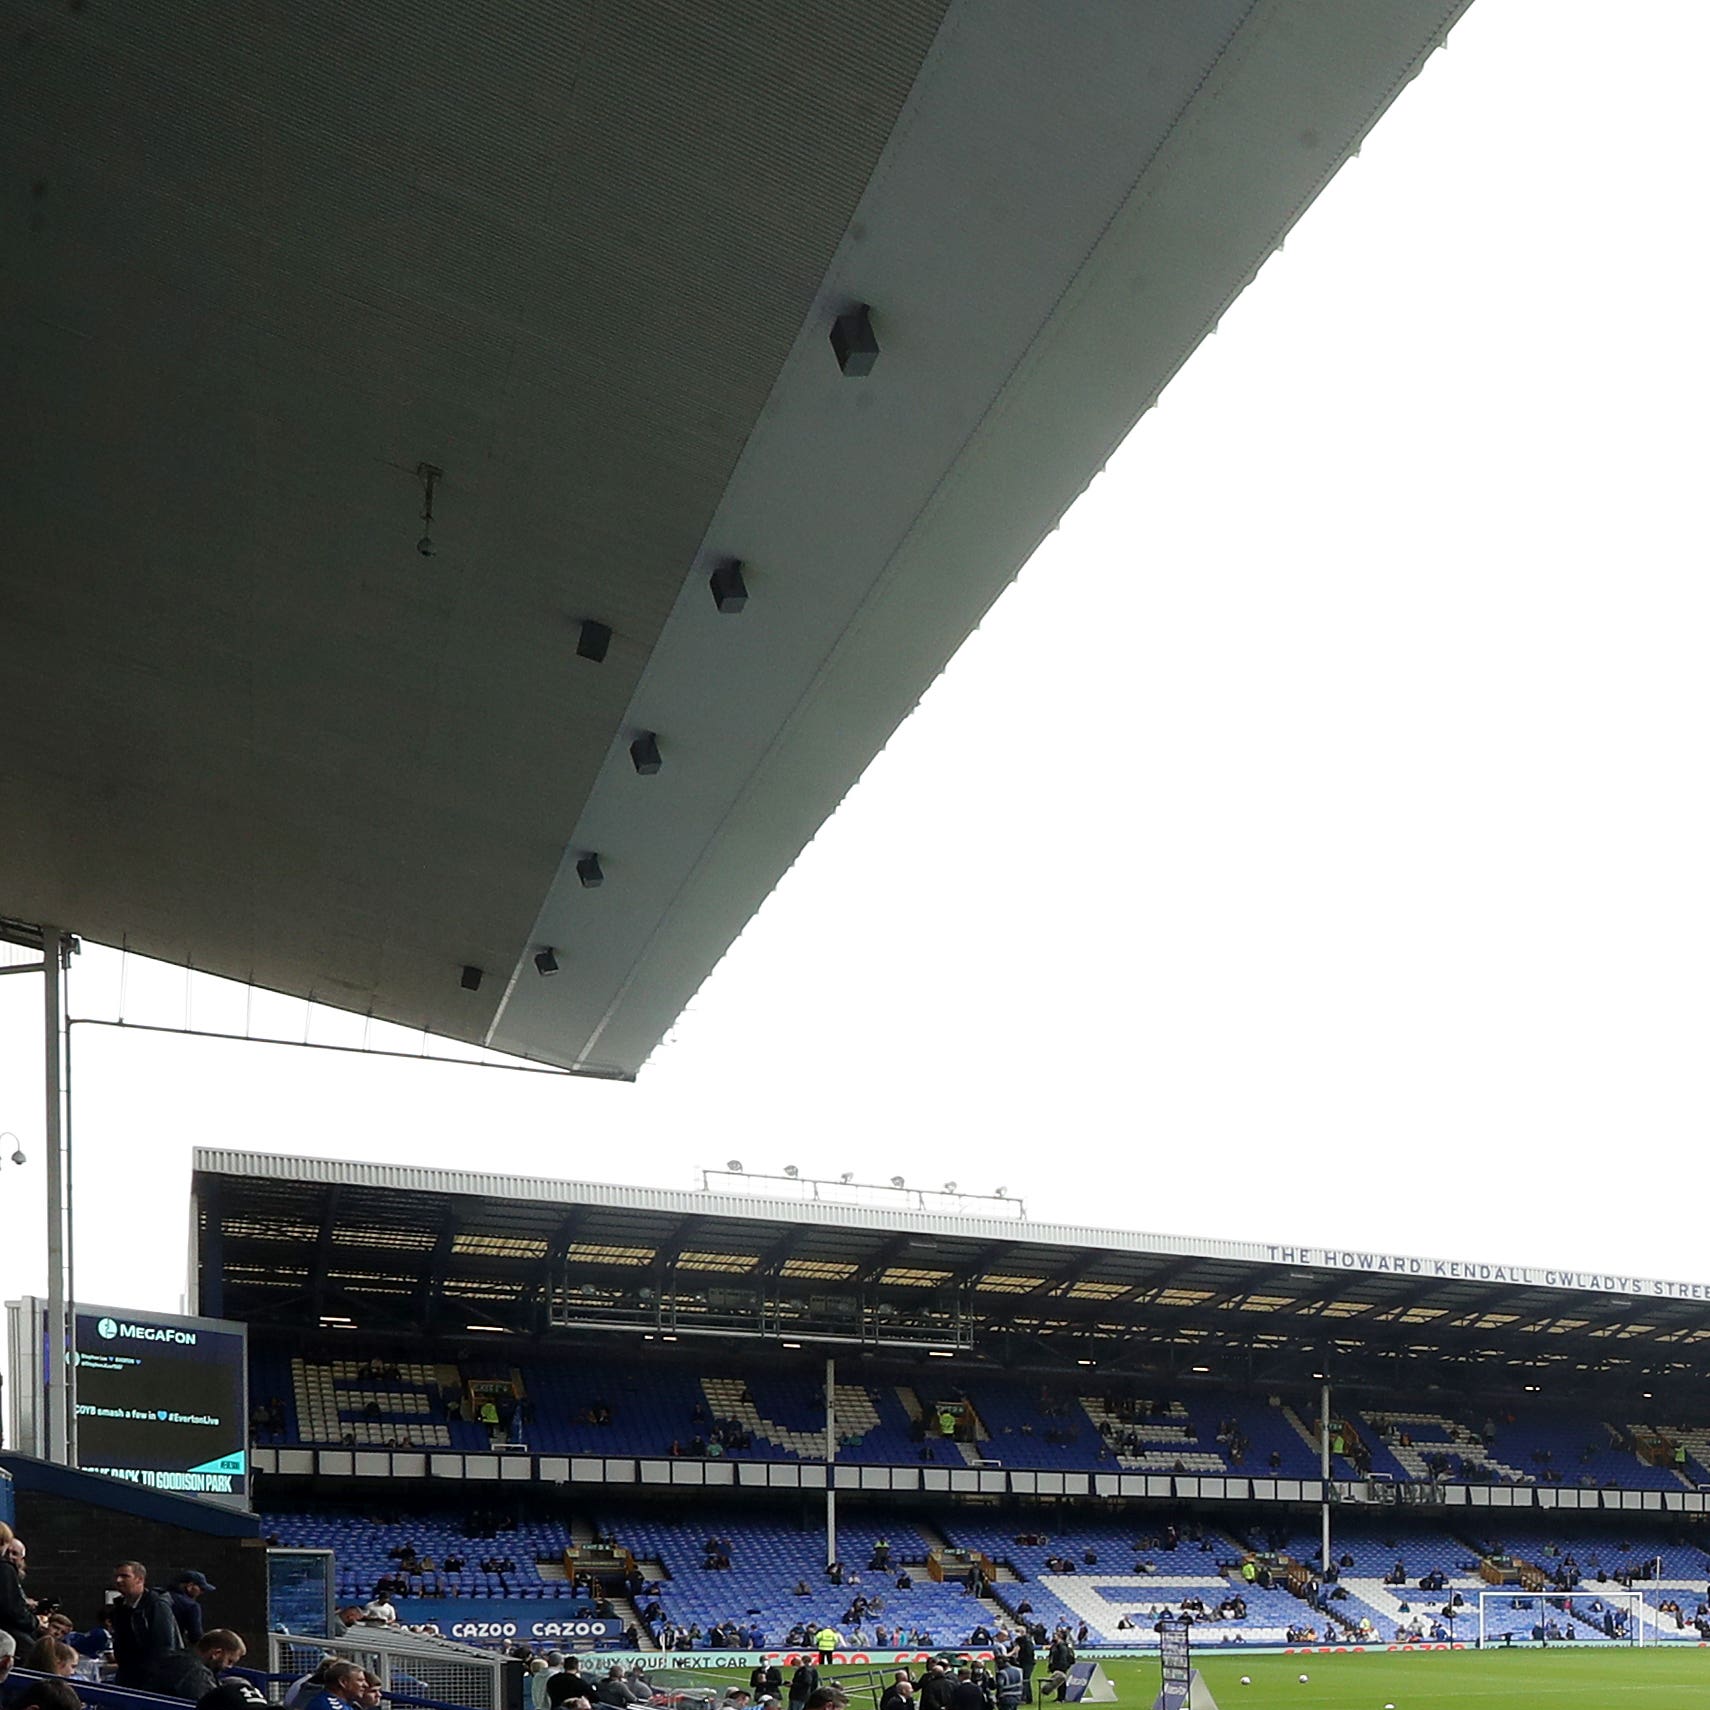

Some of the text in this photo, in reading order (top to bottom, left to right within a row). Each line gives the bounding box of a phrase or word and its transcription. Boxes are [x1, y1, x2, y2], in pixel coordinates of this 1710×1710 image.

[1267, 1246, 1311, 1264] THE
[1324, 1250, 1421, 1274] HOWARD
[1434, 1260, 1532, 1283] KENDALL
[1545, 1270, 1642, 1292] GWLADYS
[97, 1408, 124, 1417] smash
[132, 1410, 147, 1420] few
[148, 1410, 156, 1420] in
[156, 1471, 205, 1491] GOODISON
[205, 1475, 232, 1493] PARK
[452, 1623, 517, 1638] CAZOO
[532, 1622, 606, 1638] CAZOO
[625, 1658, 666, 1669] YOUR
[672, 1657, 711, 1669] NEXT
[715, 1657, 748, 1668] CAR
